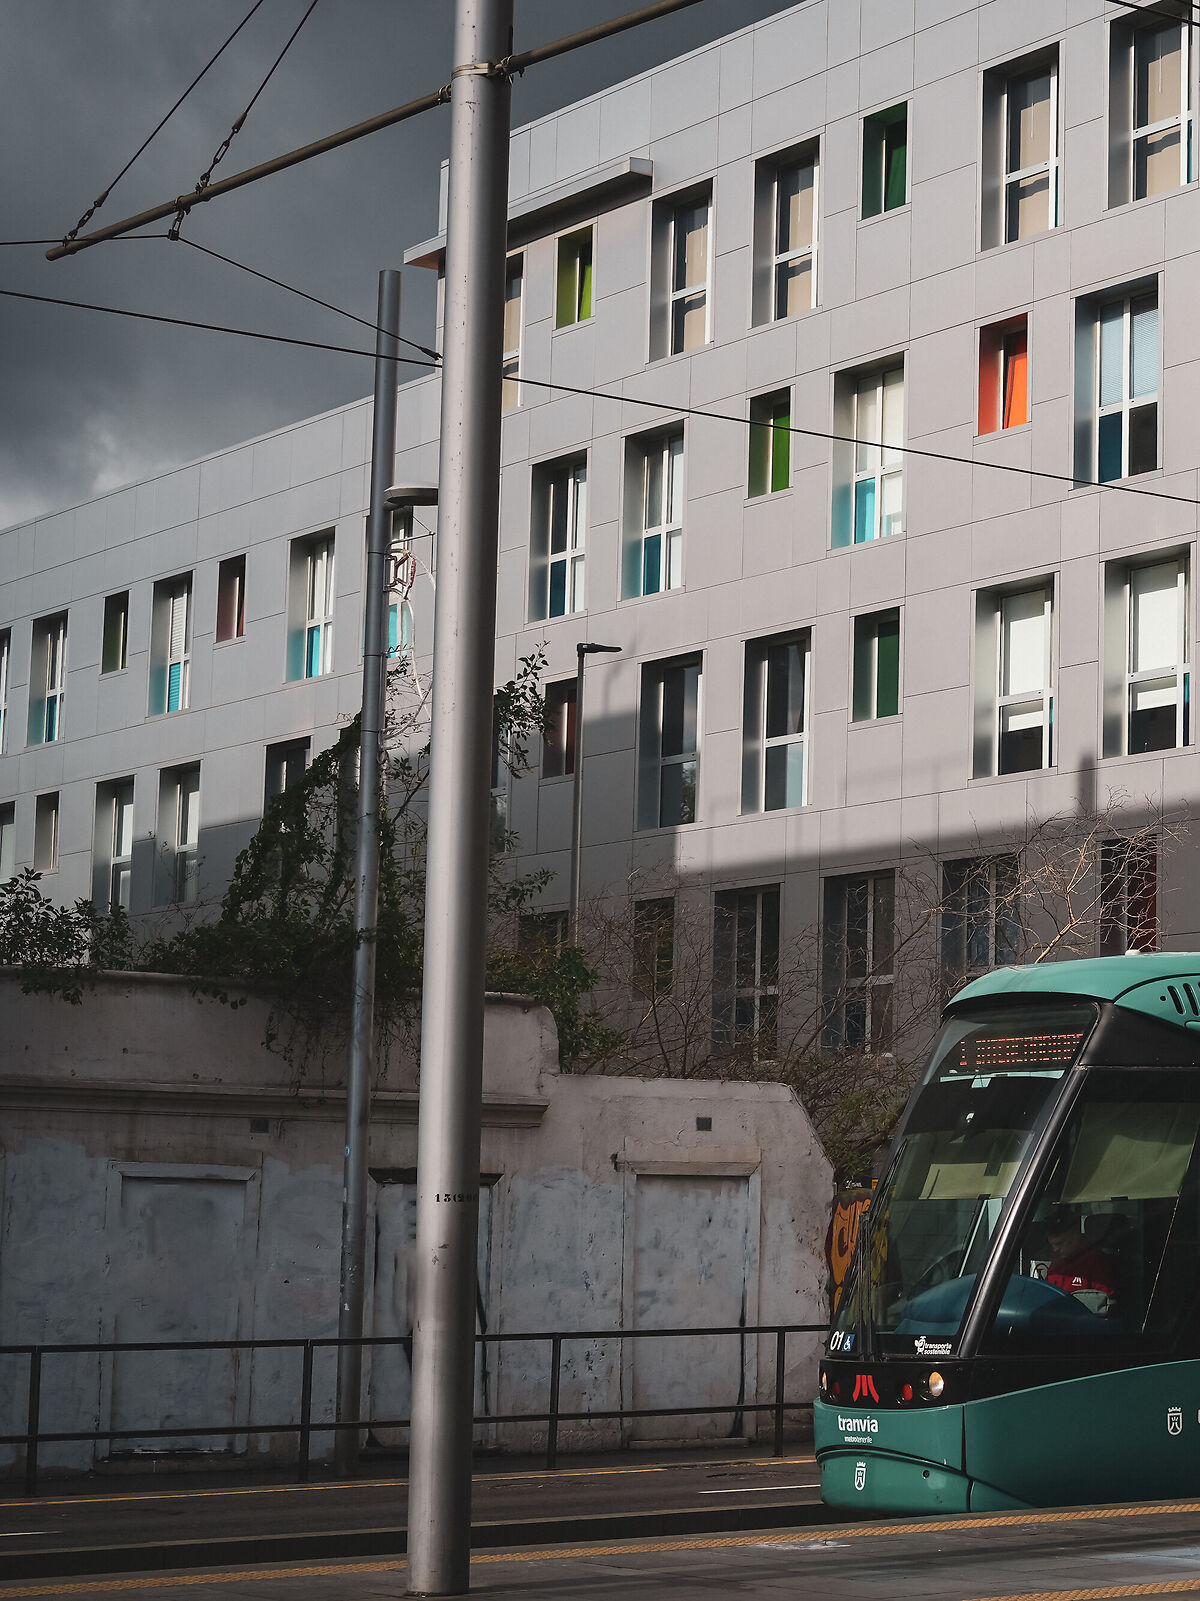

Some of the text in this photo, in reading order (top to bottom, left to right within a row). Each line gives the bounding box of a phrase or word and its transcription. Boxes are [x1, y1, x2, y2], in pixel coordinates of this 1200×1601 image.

[829, 1331, 845, 1351] 01
[925, 1342, 953, 1350] transporte
[924, 1348, 951, 1356] sostenible
[837, 1414, 879, 1433] tranvía
[844, 1435, 873, 1444] metrotenerife
